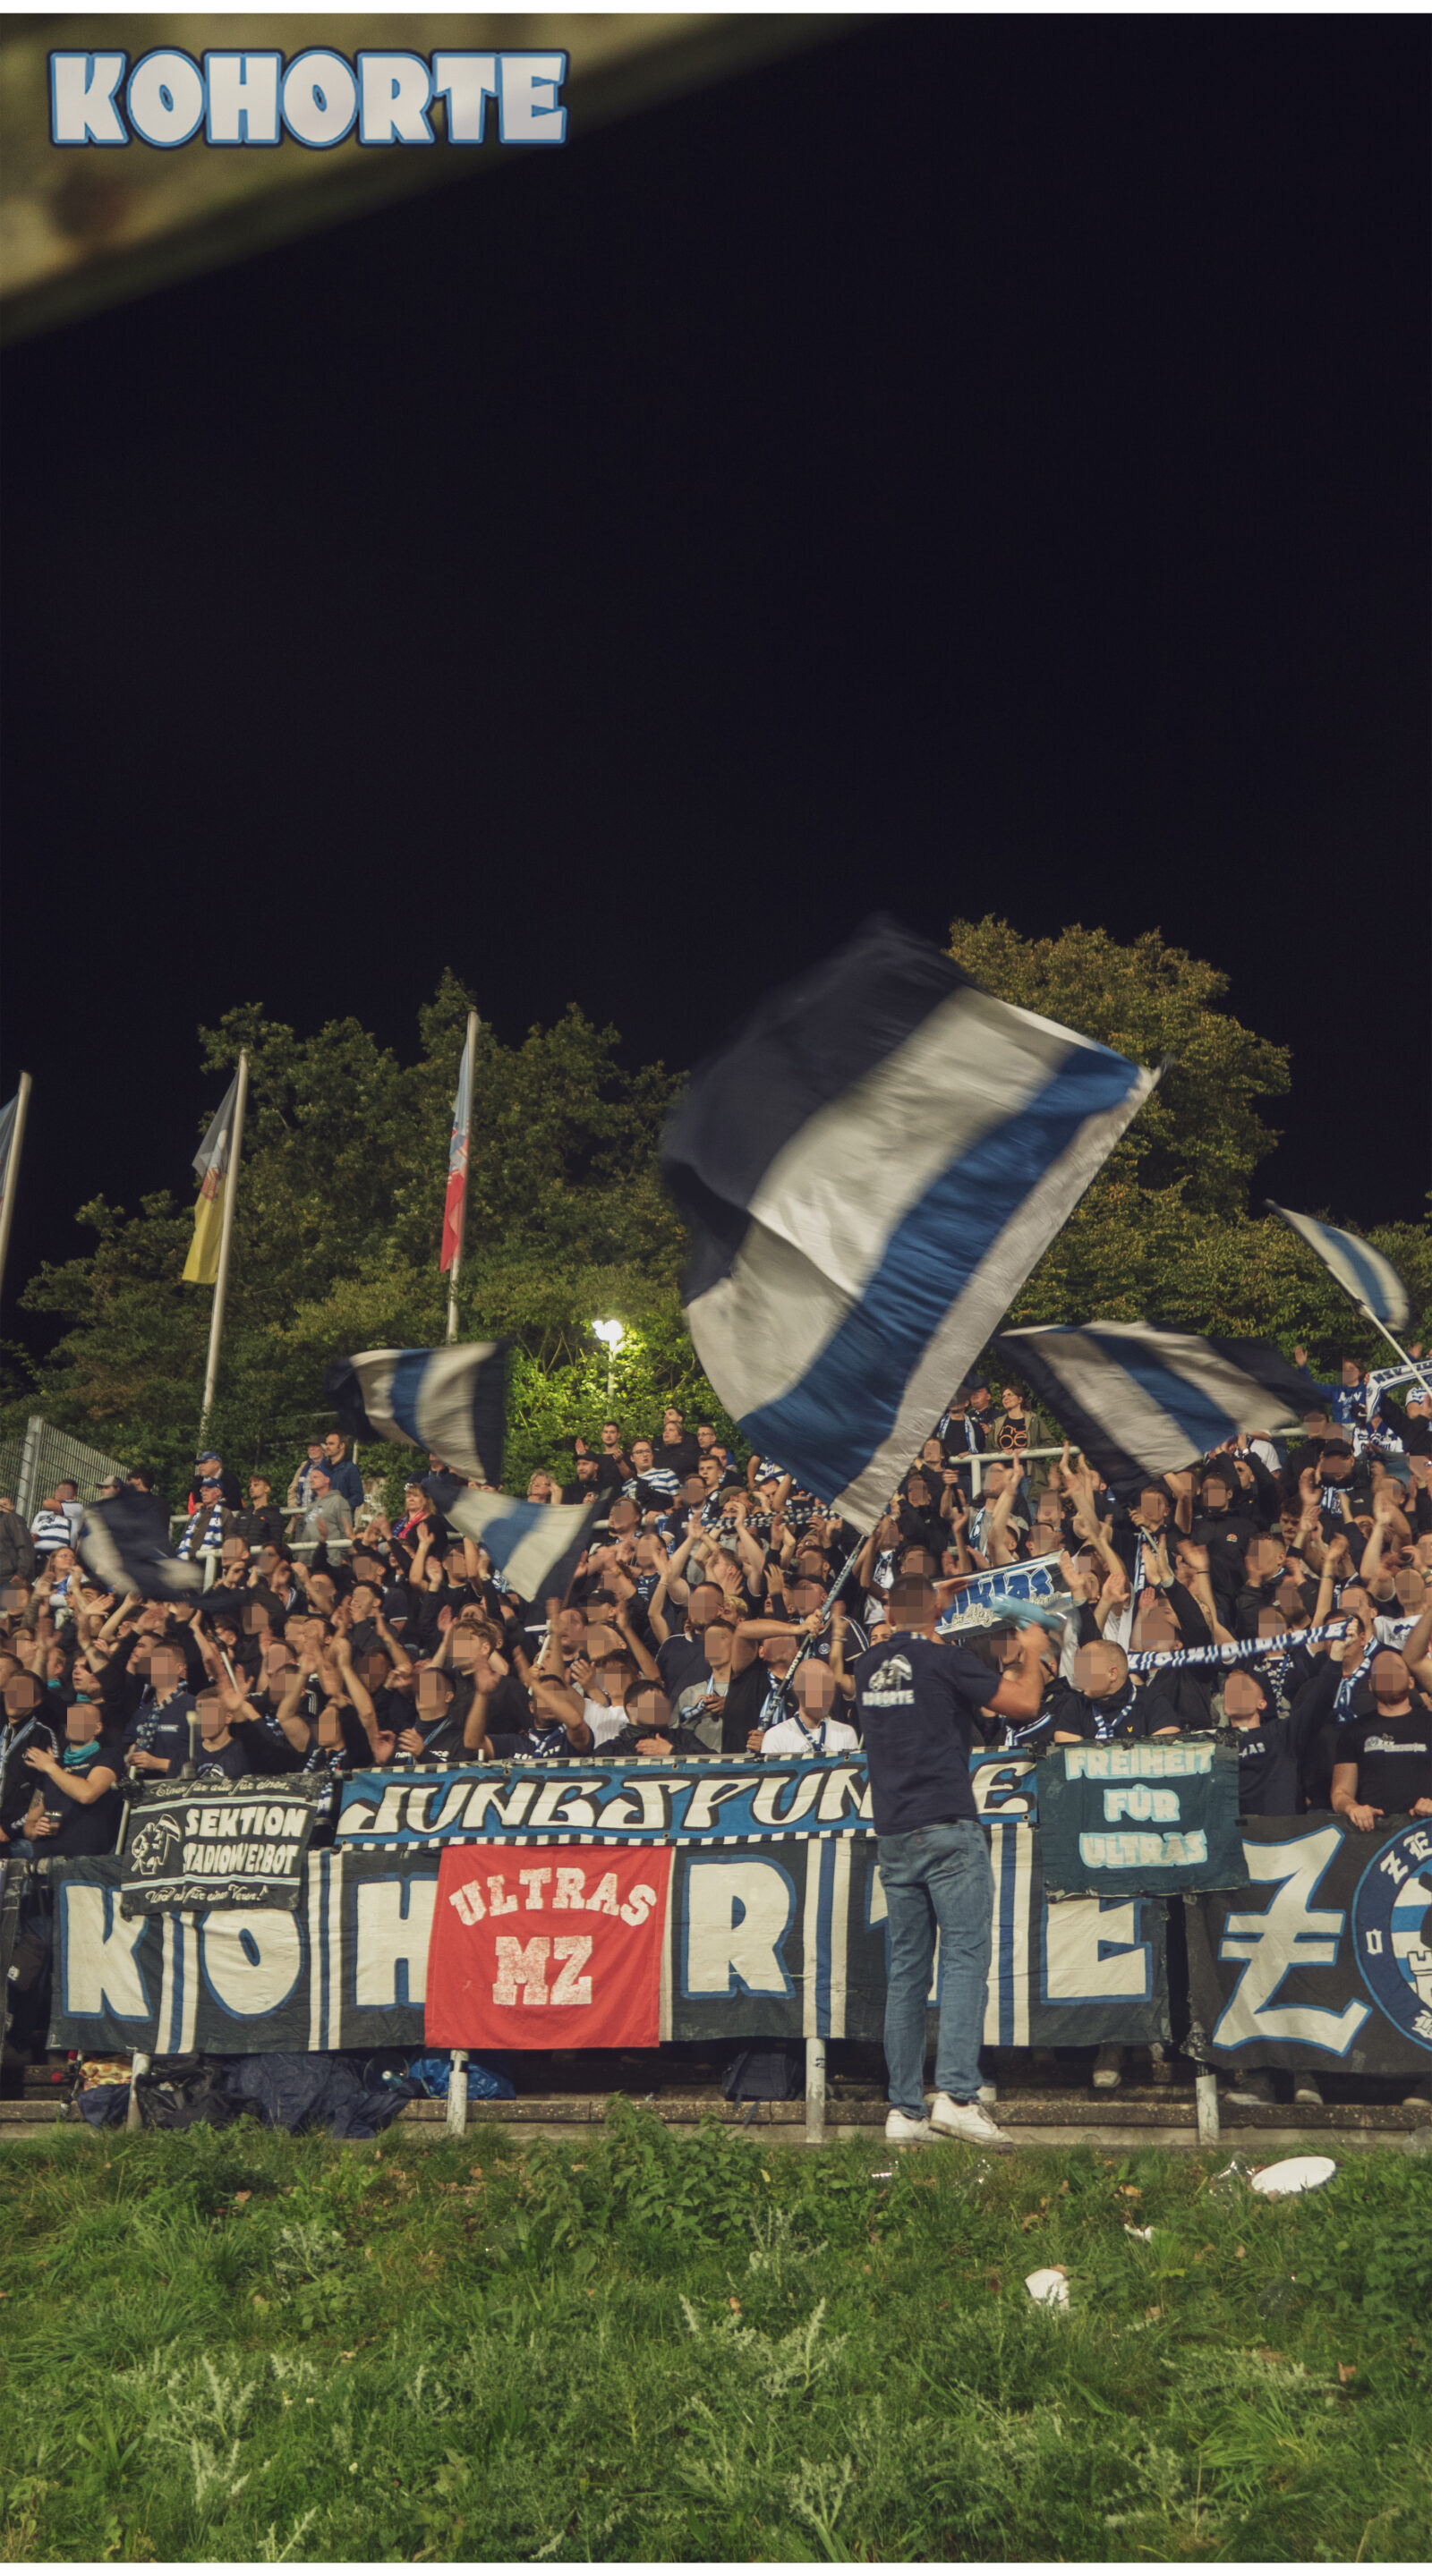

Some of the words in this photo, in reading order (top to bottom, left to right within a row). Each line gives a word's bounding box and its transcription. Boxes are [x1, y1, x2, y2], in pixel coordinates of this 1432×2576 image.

[1064, 1743, 1216, 1781] FREIHEIT
[336, 1756, 1037, 1834] JUNGSPUNE
[1104, 1783, 1181, 1822] FÜR
[184, 1806, 308, 1837] SEKTION
[1079, 1829, 1207, 1868] ULTRAS
[448, 1866, 657, 1926] ULTRAS
[492, 1935, 592, 2005] MZ
